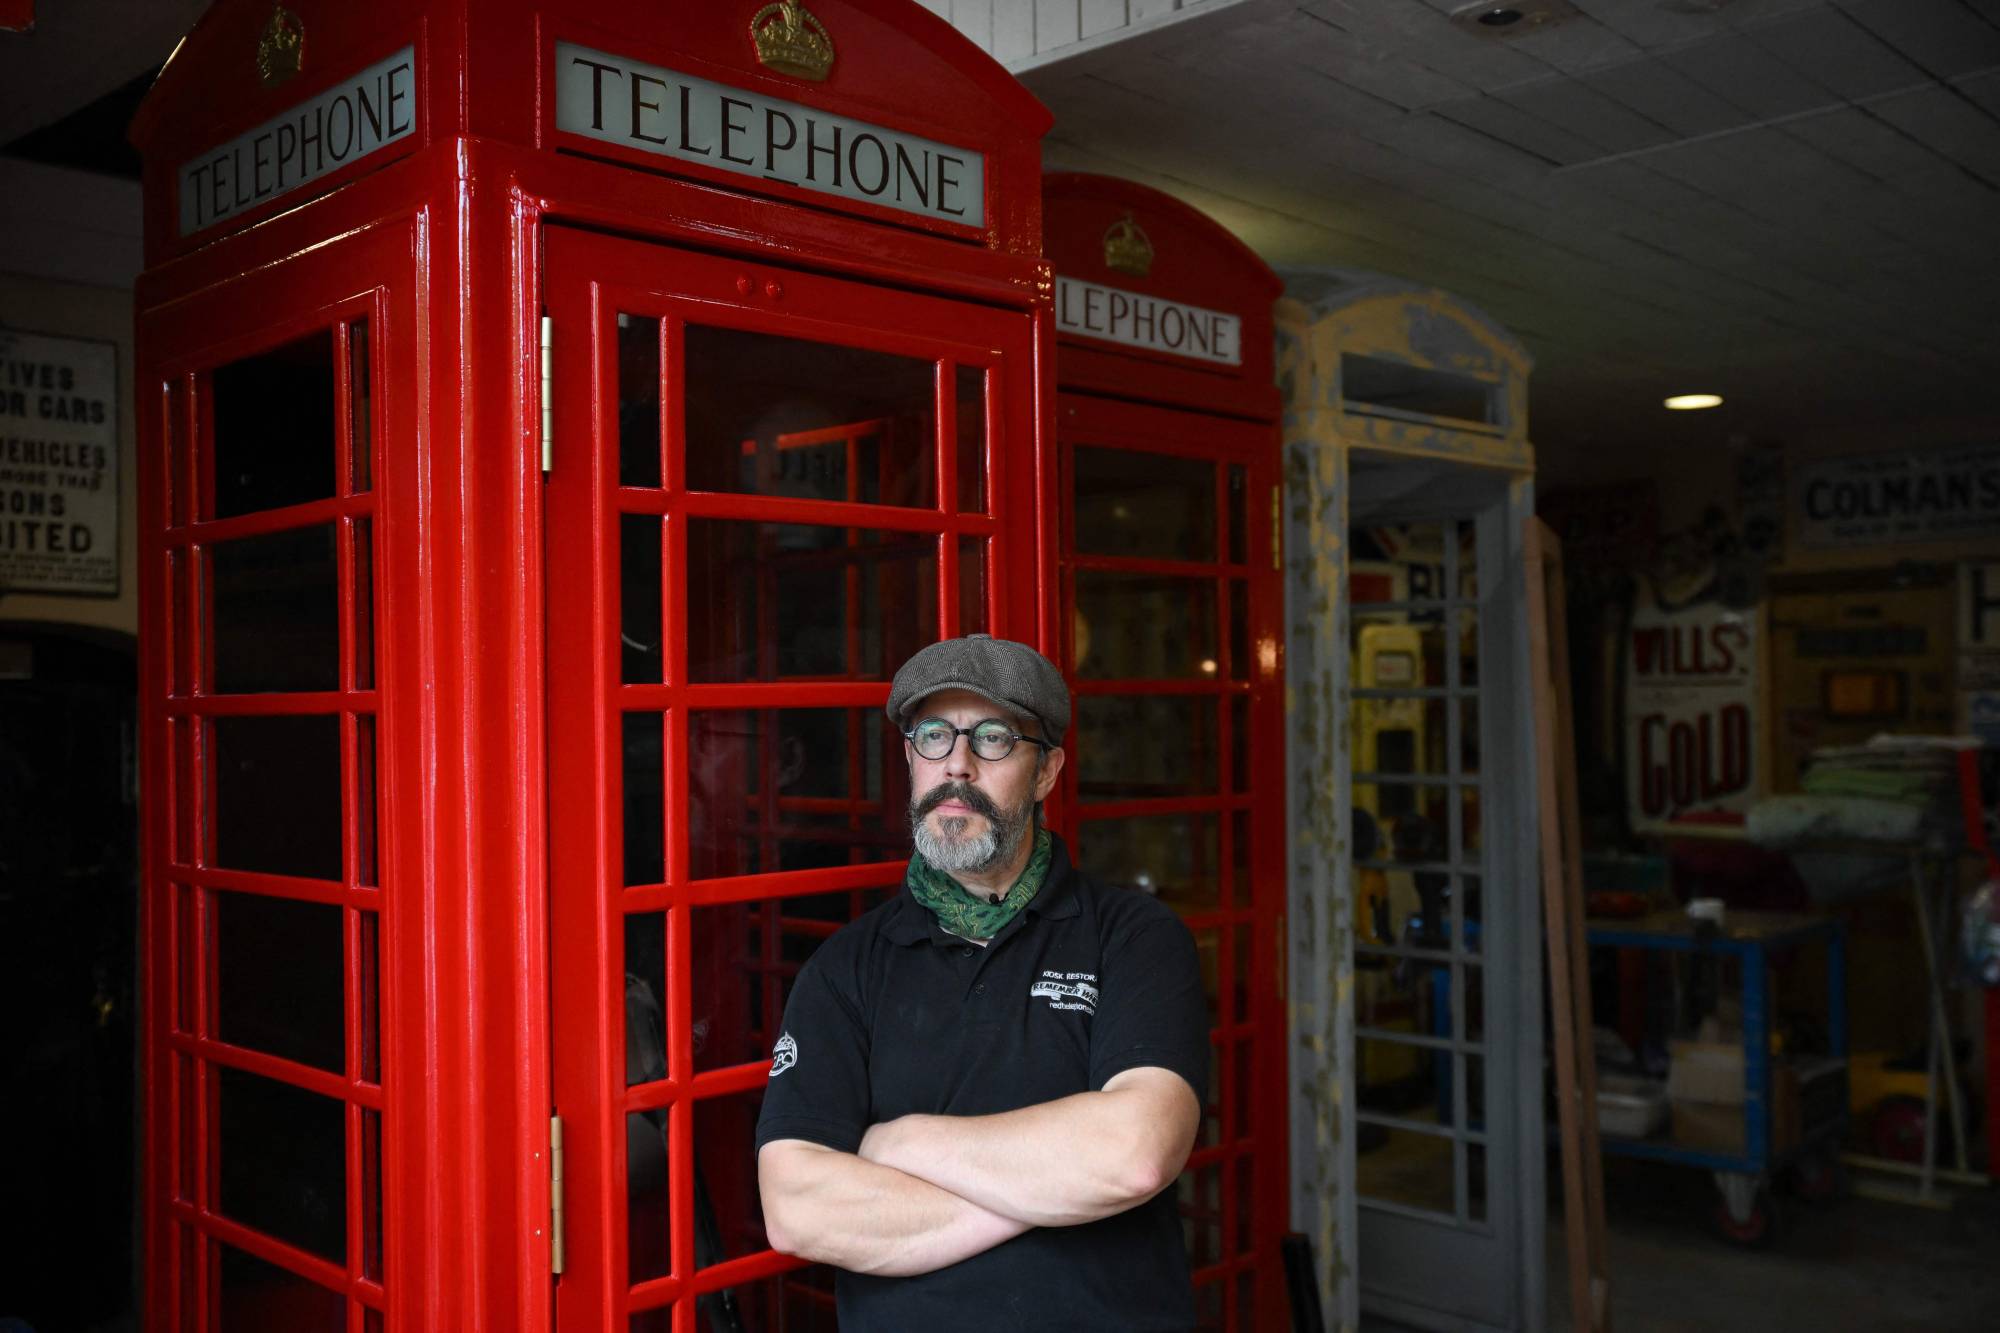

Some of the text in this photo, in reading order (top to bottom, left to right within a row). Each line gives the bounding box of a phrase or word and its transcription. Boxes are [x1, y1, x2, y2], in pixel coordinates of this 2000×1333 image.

[187, 63, 410, 226] TELEPHONE
[573, 57, 966, 217] TELEPHONE
[1061, 281, 1230, 358] LEPHONE
[0, 359, 74, 391] IVES
[39, 395, 105, 424] CARS
[0, 521, 91, 553] ITED
[1639, 703, 1748, 817] GOLD
[1033, 983, 1080, 995] REMEMBER
[1066, 973, 1098, 982] RESTOR
